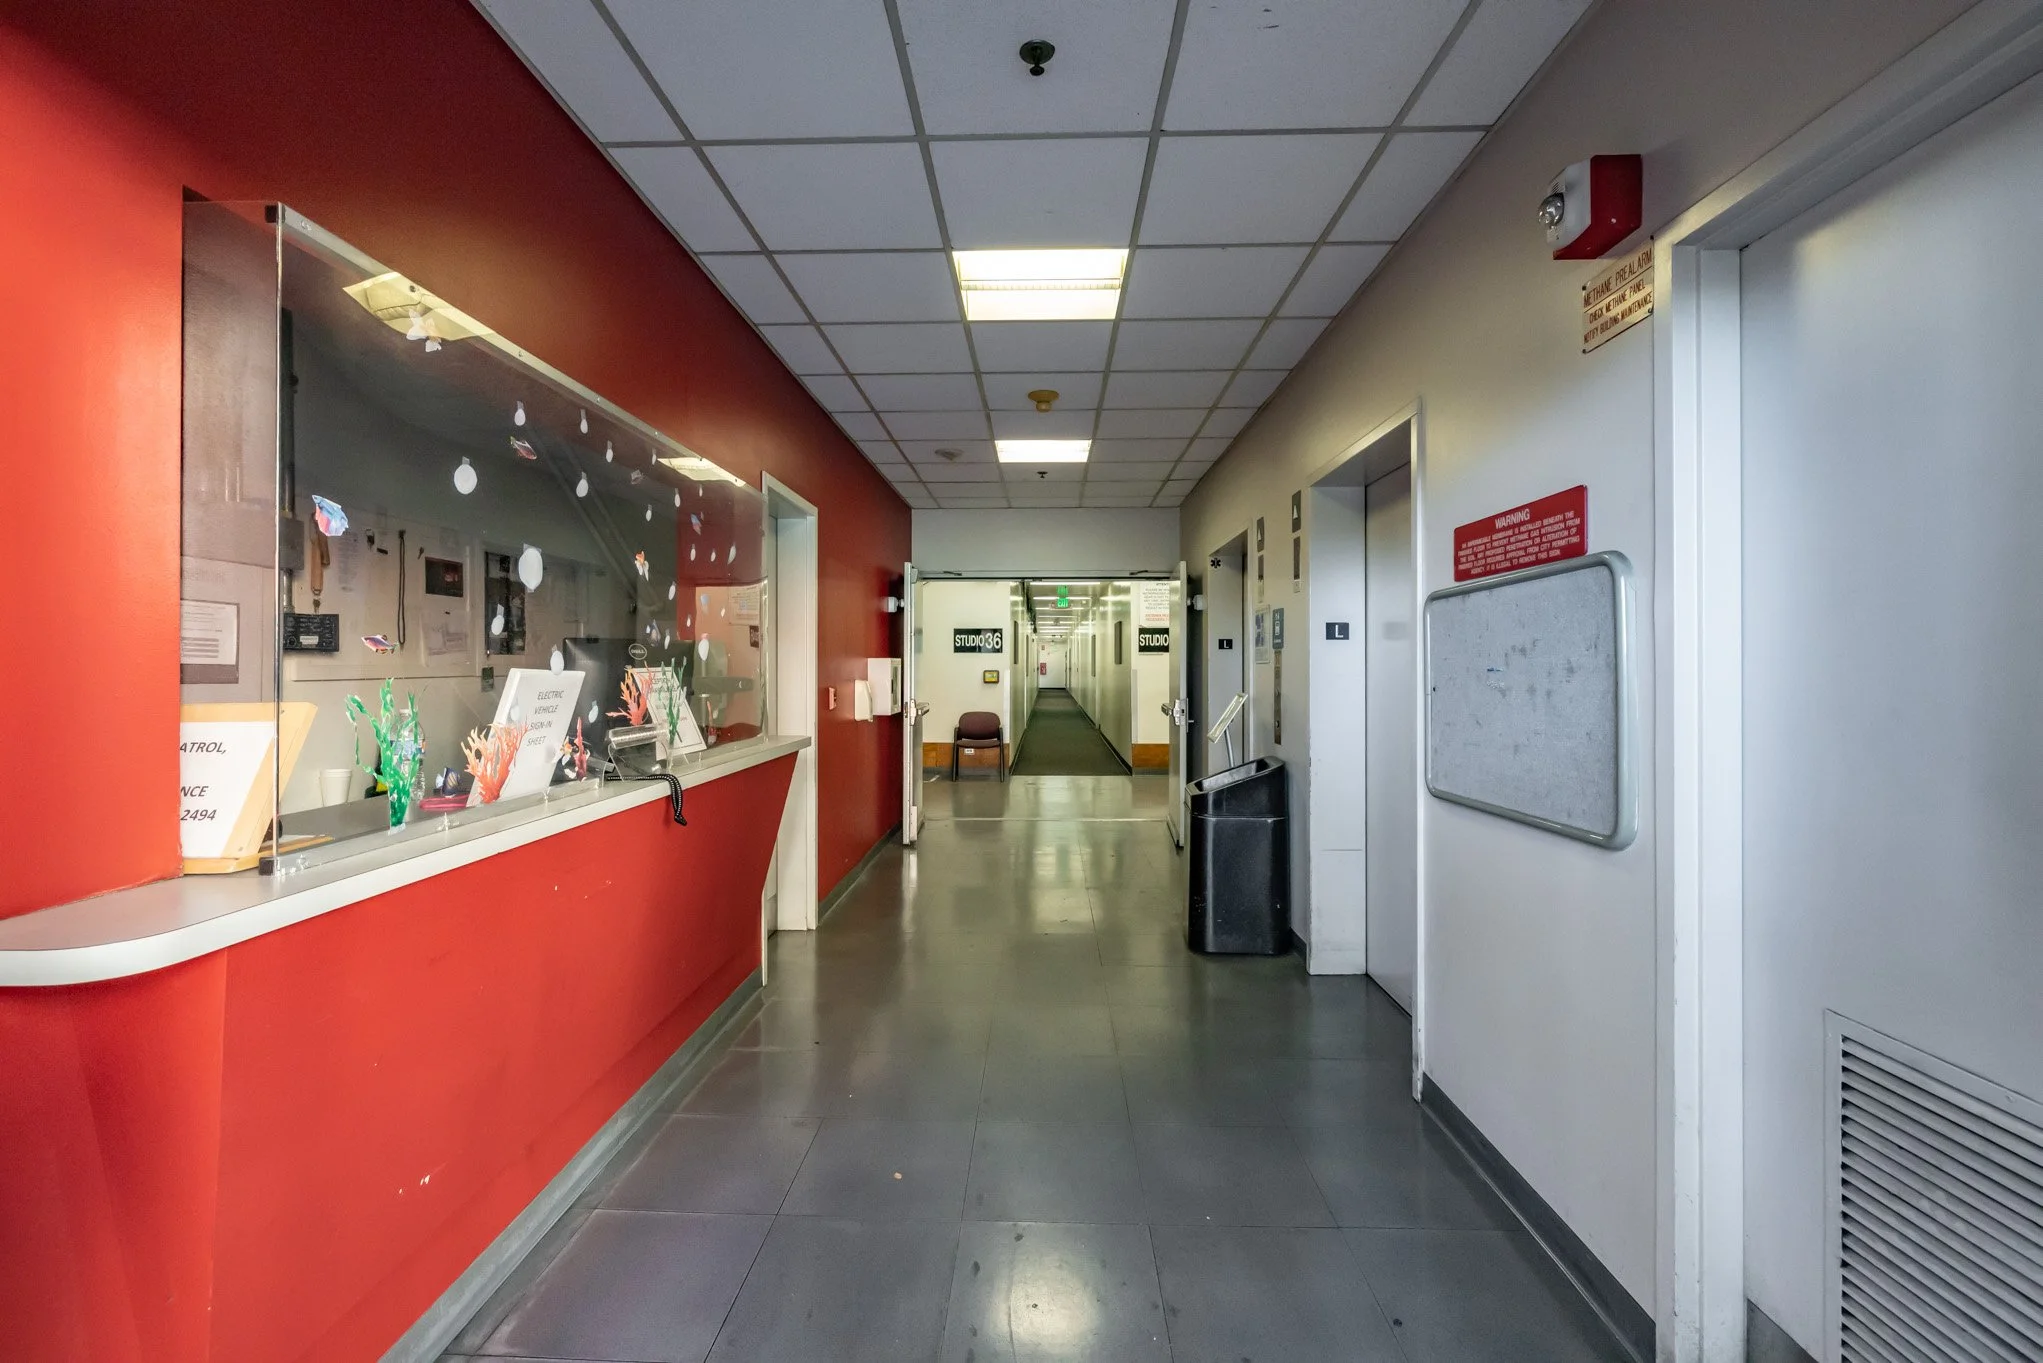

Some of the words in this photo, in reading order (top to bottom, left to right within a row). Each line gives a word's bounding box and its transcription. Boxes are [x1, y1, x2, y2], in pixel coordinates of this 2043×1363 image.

[1583, 277, 1612, 309] METHANE
[1615, 248, 1653, 287] PREALARM
[1589, 307, 1604, 324] CHECK
[1605, 289, 1628, 313] METHANE
[1629, 279, 1646, 298] PANEL
[1583, 327, 1599, 345] NOTIFY
[1599, 313, 1620, 335] BUILDING
[1620, 291, 1653, 321] MAINTENANCE
[1494, 508, 1530, 530] WARNING
[1564, 510, 1575, 520] THE
[1530, 529, 1540, 538] GAS
[1565, 517, 1580, 528] FROM
[1335, 624, 1344, 638] L
[955, 634, 985, 647] STUDIO
[985, 632, 1002, 649] 36
[1139, 634, 1169, 647] STUDIO
[1223, 640, 1229, 649] L
[537, 690, 564, 700] ELECTRIC
[534, 705, 558, 715] VEHICLE
[529, 721, 553, 731] SIGN-IN
[526, 736, 547, 746] SHEET
